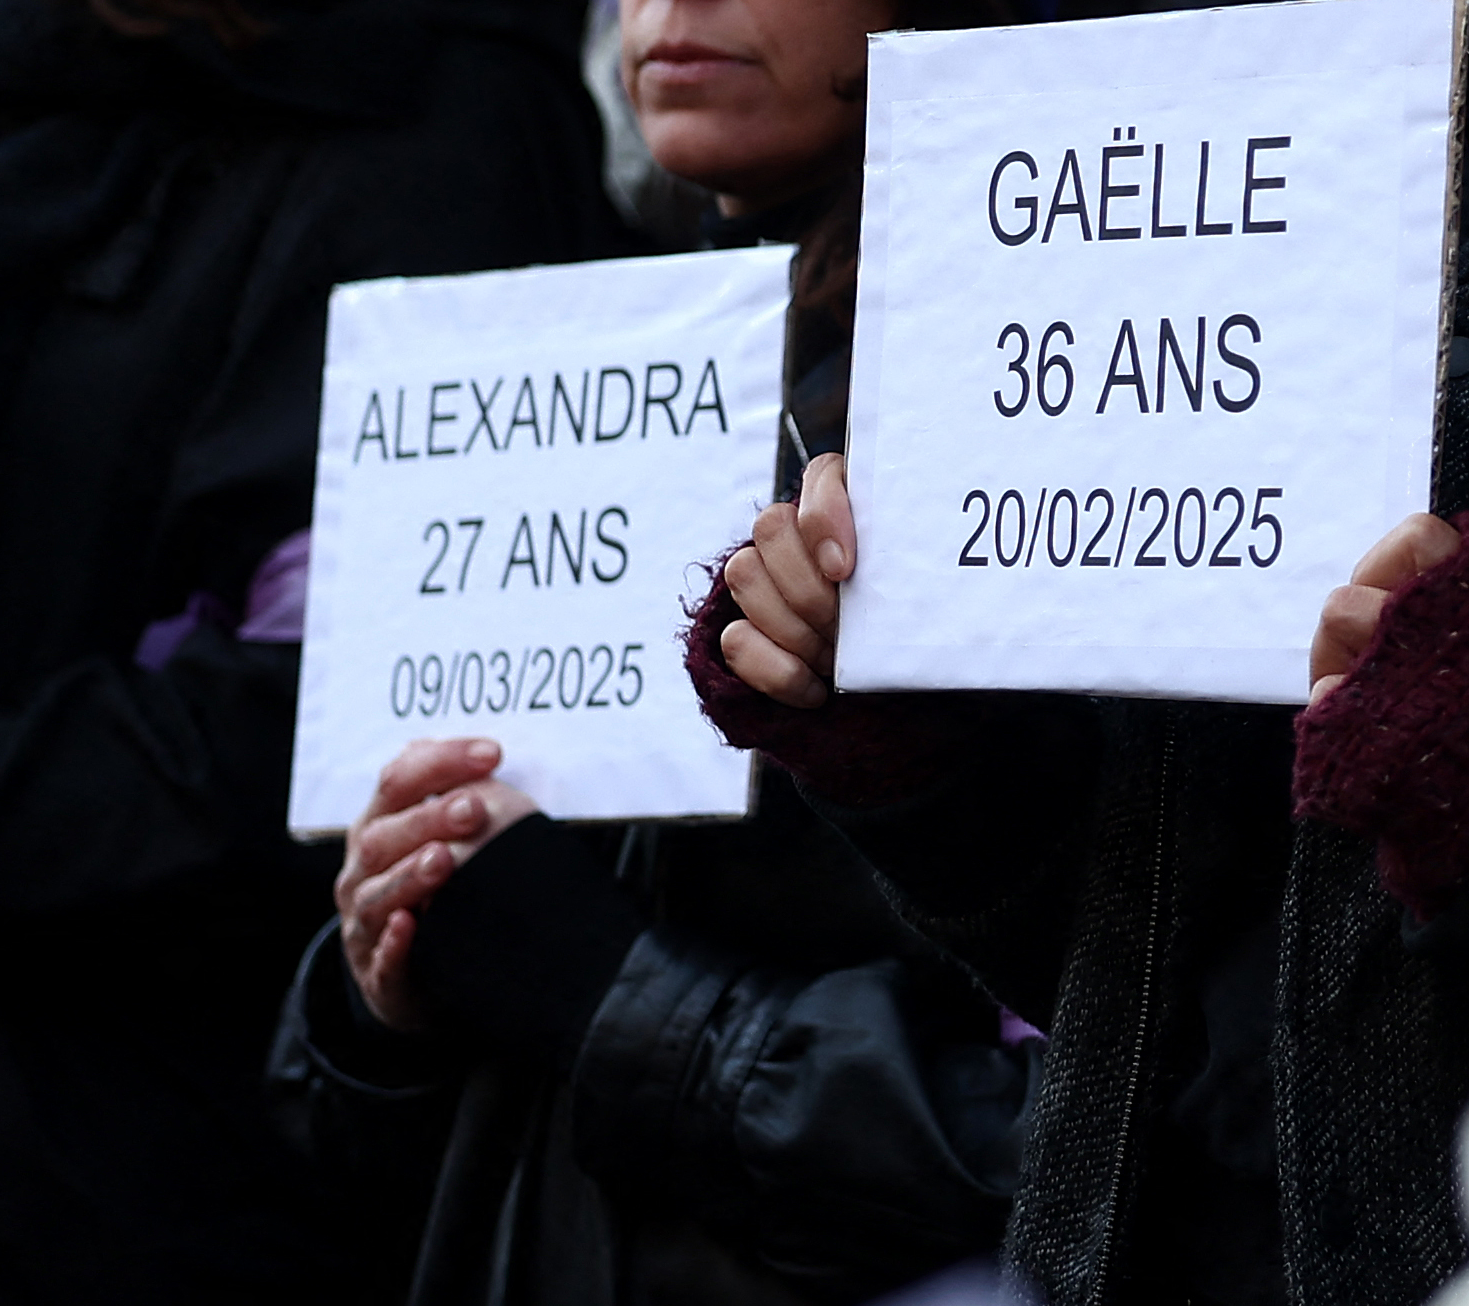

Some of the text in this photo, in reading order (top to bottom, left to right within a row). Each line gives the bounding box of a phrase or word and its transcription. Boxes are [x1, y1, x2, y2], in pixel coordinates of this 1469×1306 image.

[987, 125, 1293, 248] GAËLLE
[354, 358, 730, 463] ALEXANDRA
[993, 312, 1263, 419] 36 ANS
[419, 506, 630, 595] 27 ANS
[957, 485, 1284, 569] 20/02/2025
[390, 643, 644, 719] 09/03/2025
